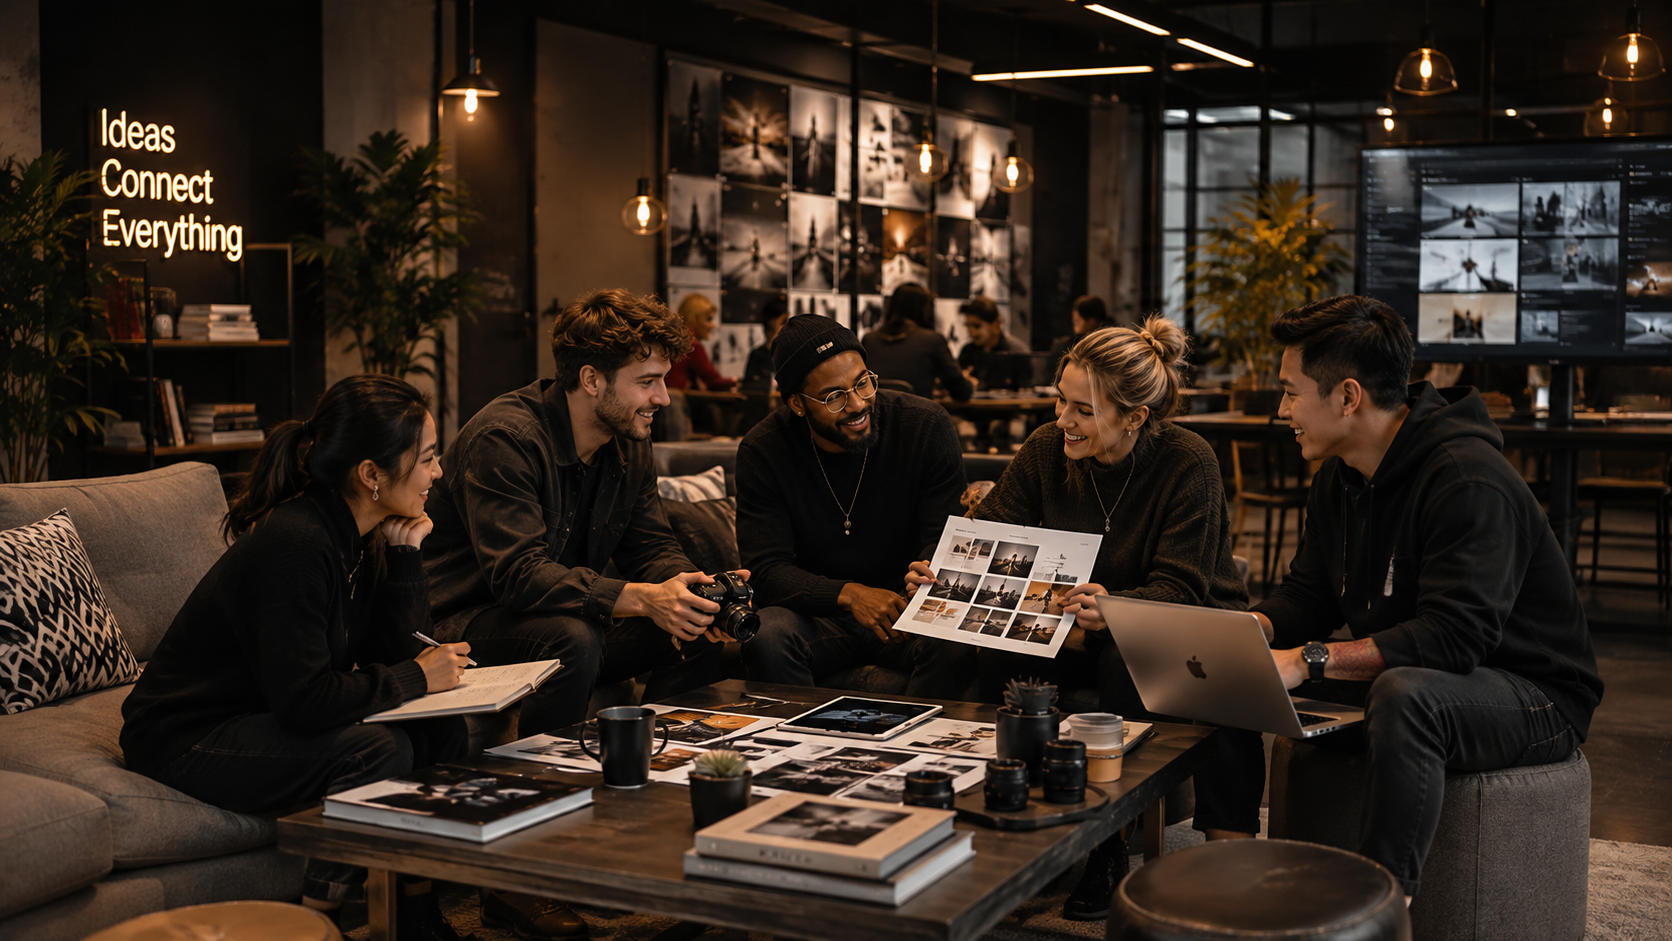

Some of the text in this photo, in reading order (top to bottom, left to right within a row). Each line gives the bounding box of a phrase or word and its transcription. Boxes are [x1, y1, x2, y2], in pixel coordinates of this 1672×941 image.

[101, 108, 176, 153] Ideas
[101, 158, 214, 205] Connect
[103, 209, 242, 262] Everything
